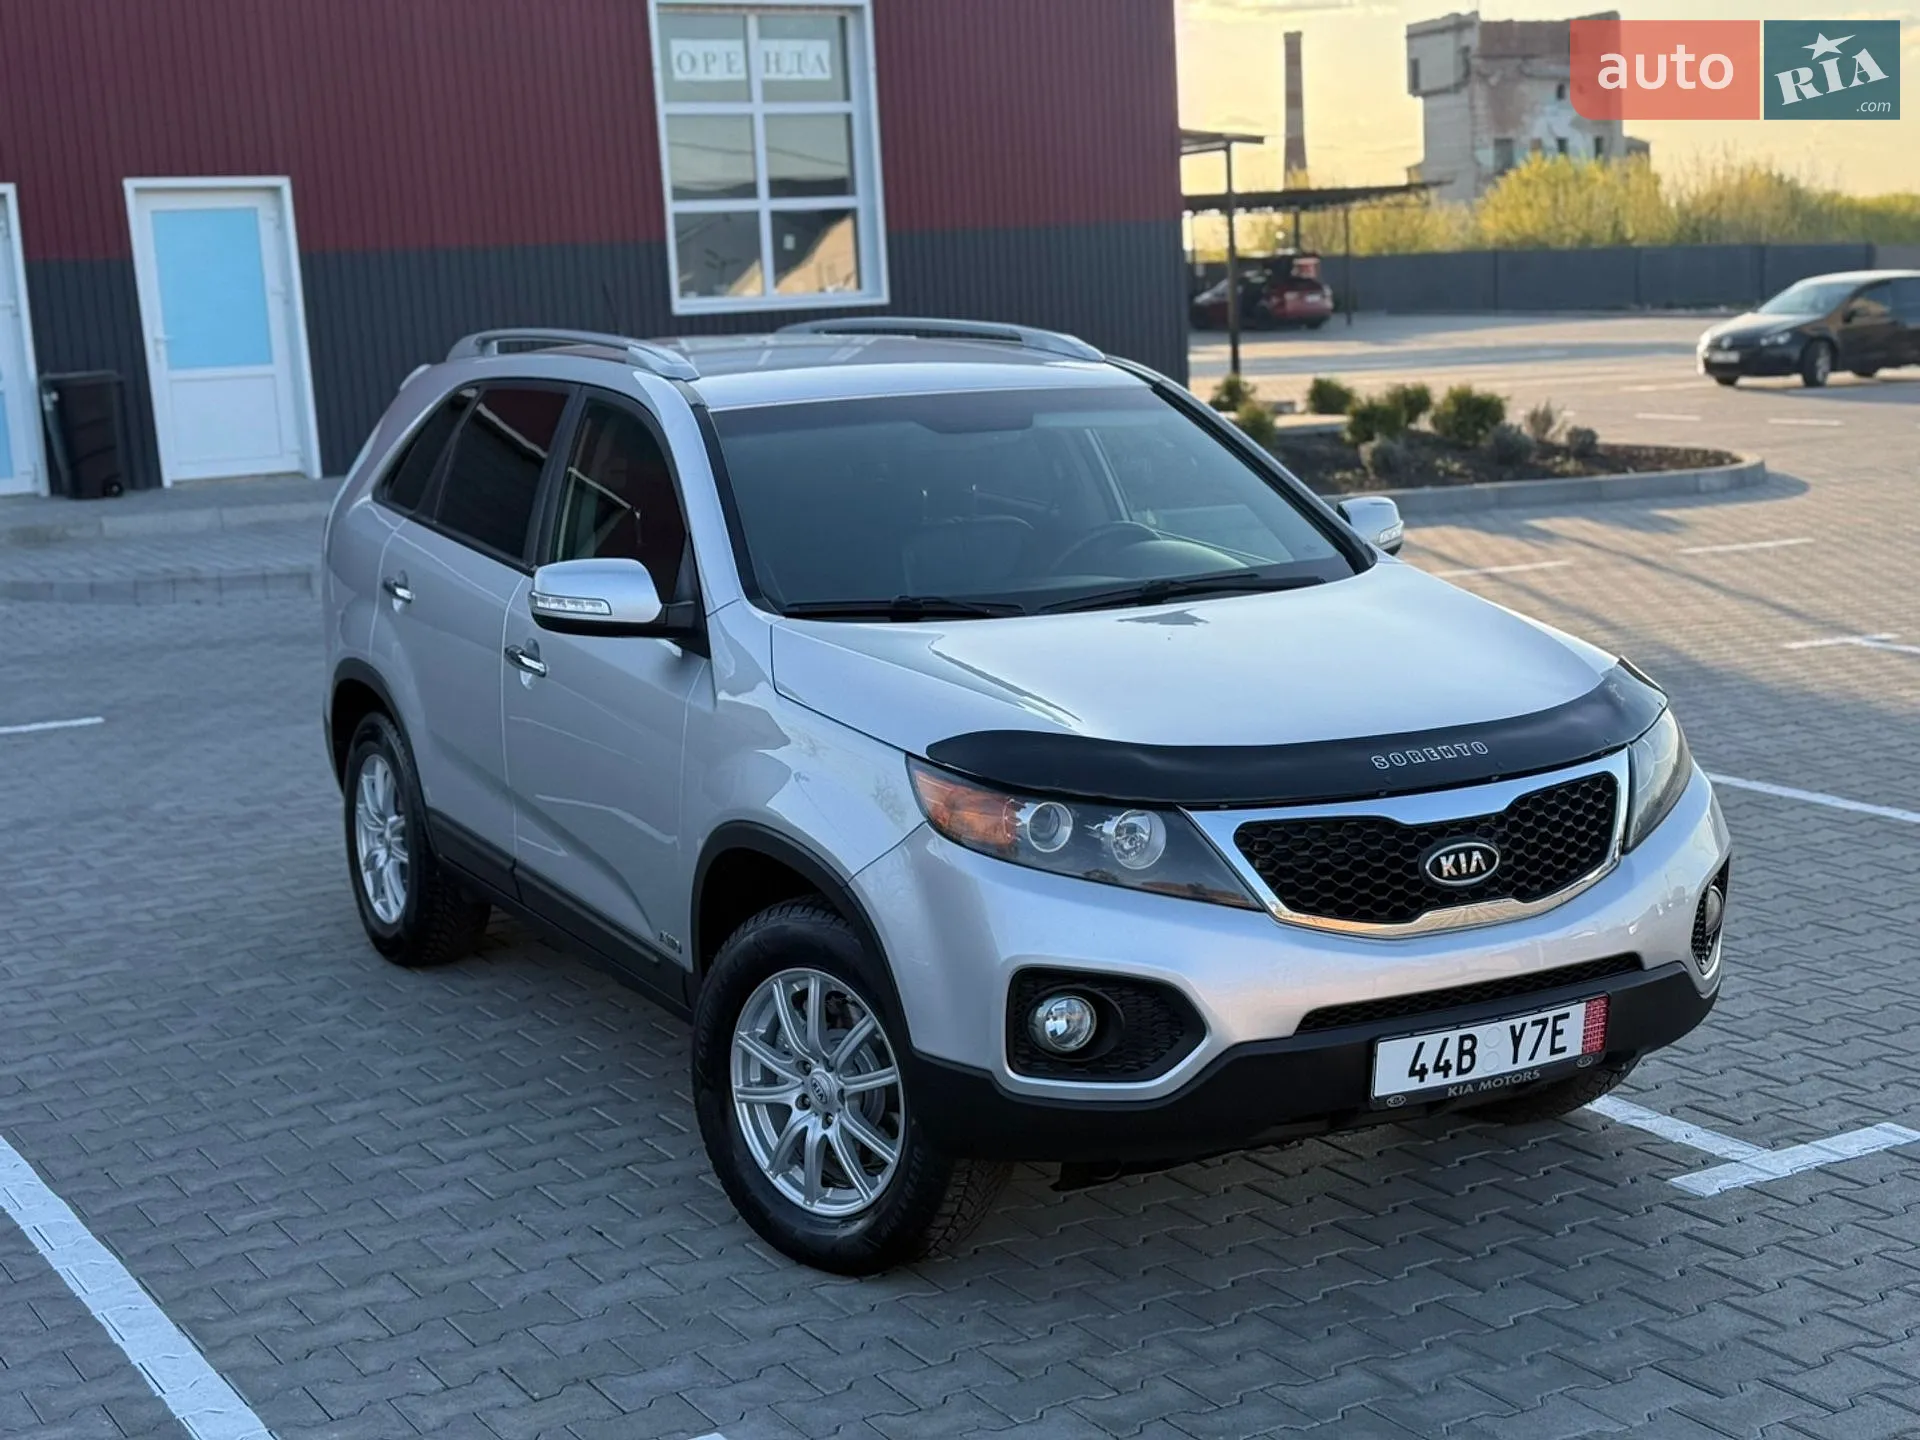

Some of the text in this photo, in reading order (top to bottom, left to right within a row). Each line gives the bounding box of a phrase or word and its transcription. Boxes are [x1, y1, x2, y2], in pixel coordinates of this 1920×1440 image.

[1371, 741, 1489, 770] SORENTO
[1439, 850, 1487, 878] KIA
[1408, 1034, 1478, 1083] 44B
[1509, 1012, 1571, 1065] Y7E
[1447, 1069, 1541, 1097] KIA MOTORS
